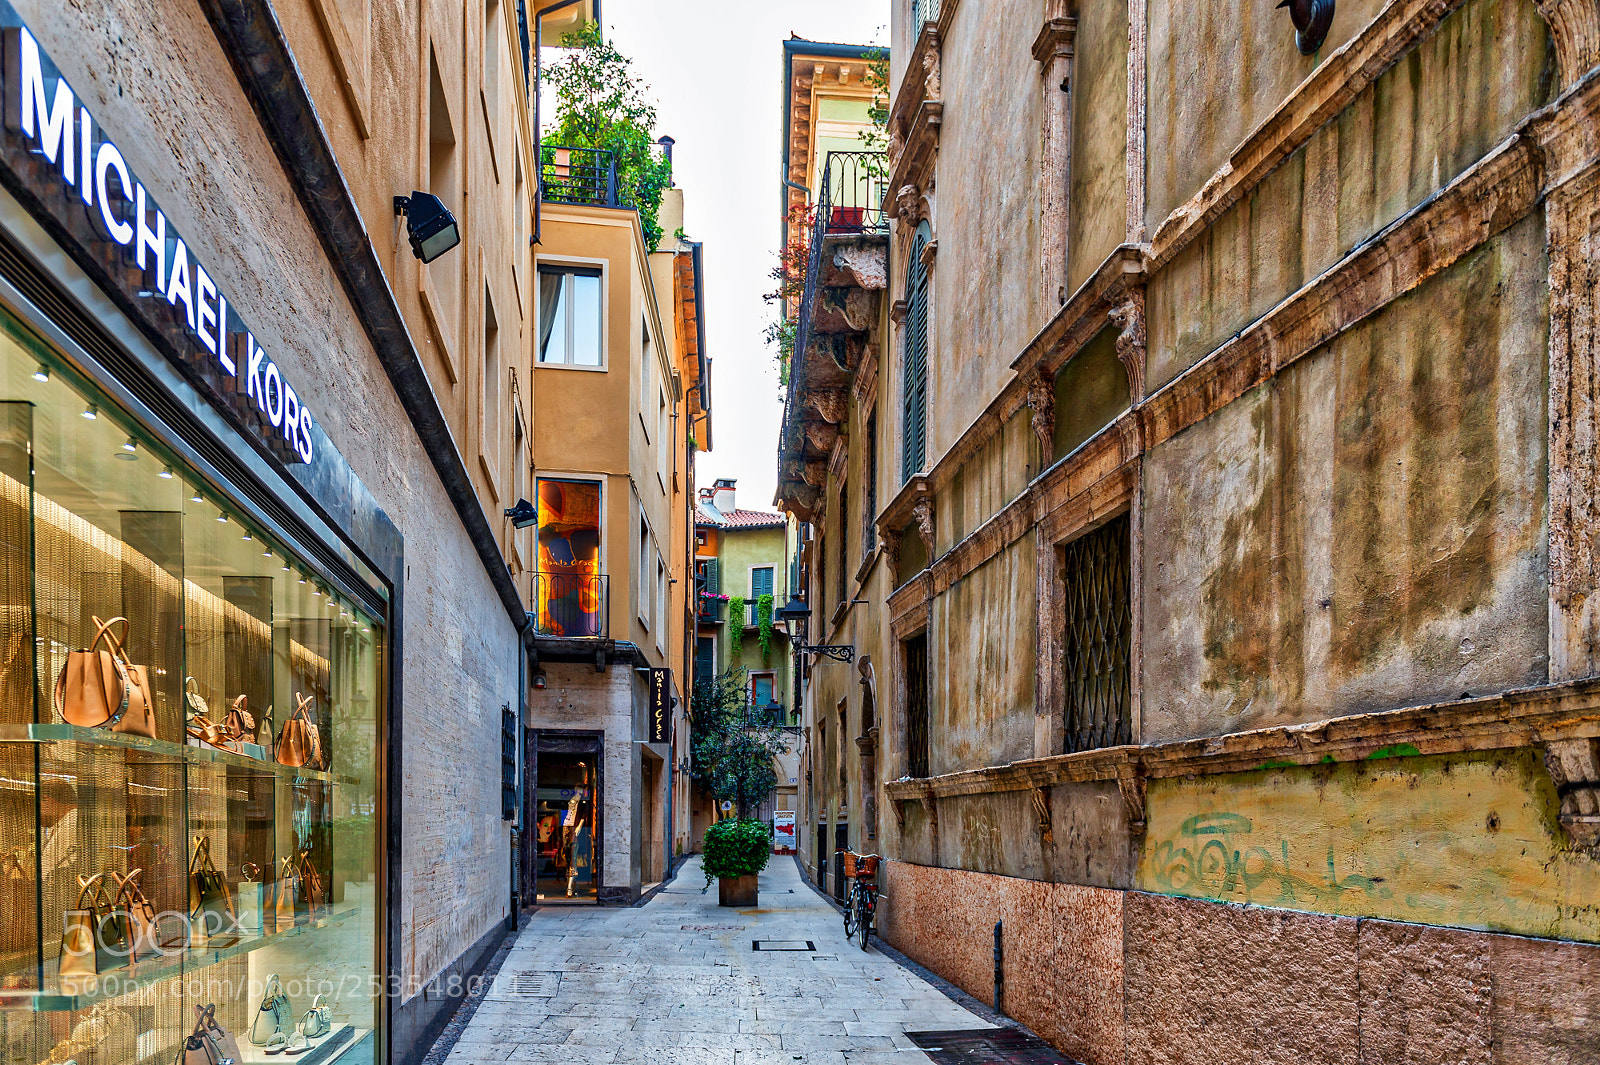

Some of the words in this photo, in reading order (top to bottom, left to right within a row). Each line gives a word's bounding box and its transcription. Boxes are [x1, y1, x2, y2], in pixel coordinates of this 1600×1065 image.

[20, 25, 237, 377] MICHAEL
[247, 331, 314, 465] KORS
[654, 670, 665, 707] Manila
